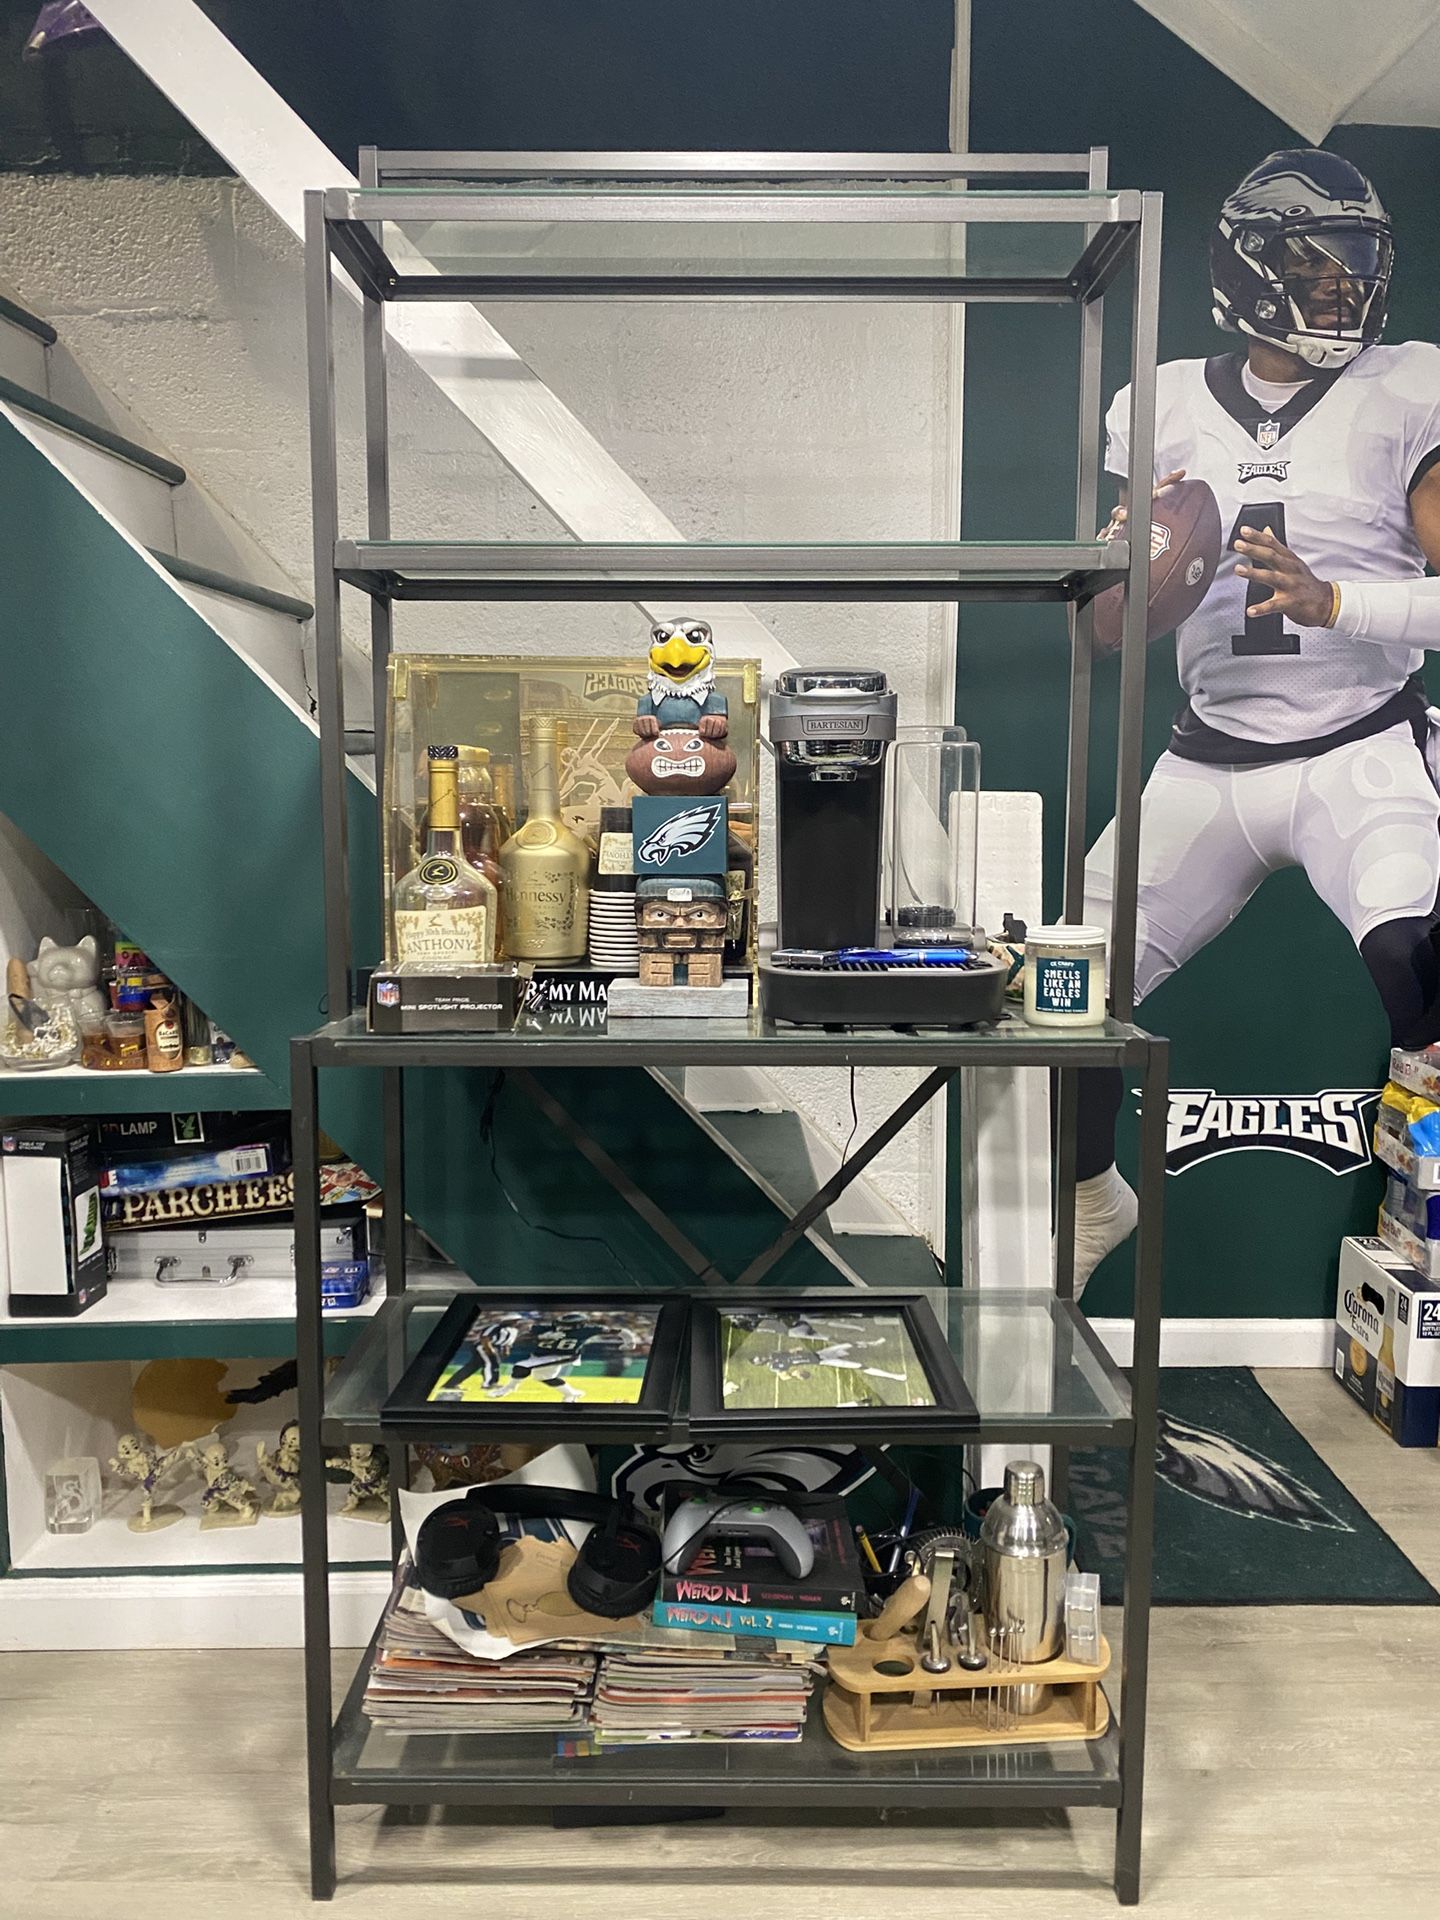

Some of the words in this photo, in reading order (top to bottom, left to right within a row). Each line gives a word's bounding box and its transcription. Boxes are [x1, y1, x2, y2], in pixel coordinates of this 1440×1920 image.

[1239, 461, 1288, 481] EAGLES
[810, 721, 860, 729] BARTESIAN
[406, 938, 473, 954] ANTHONY
[1044, 969, 1081, 979] SMELLS
[1043, 979, 1064, 989] LIKE
[1068, 980, 1081, 989] AN
[1043, 988, 1080, 998] EAGLES
[1051, 997, 1071, 1007] WIN
[120, 1121, 158, 1136] LAMP
[1167, 1092, 1365, 1157] EAGLES
[1344, 1289, 1379, 1335] Corona
[1351, 1316, 1369, 1343] Extra
[765, 1615, 774, 1630] 2
